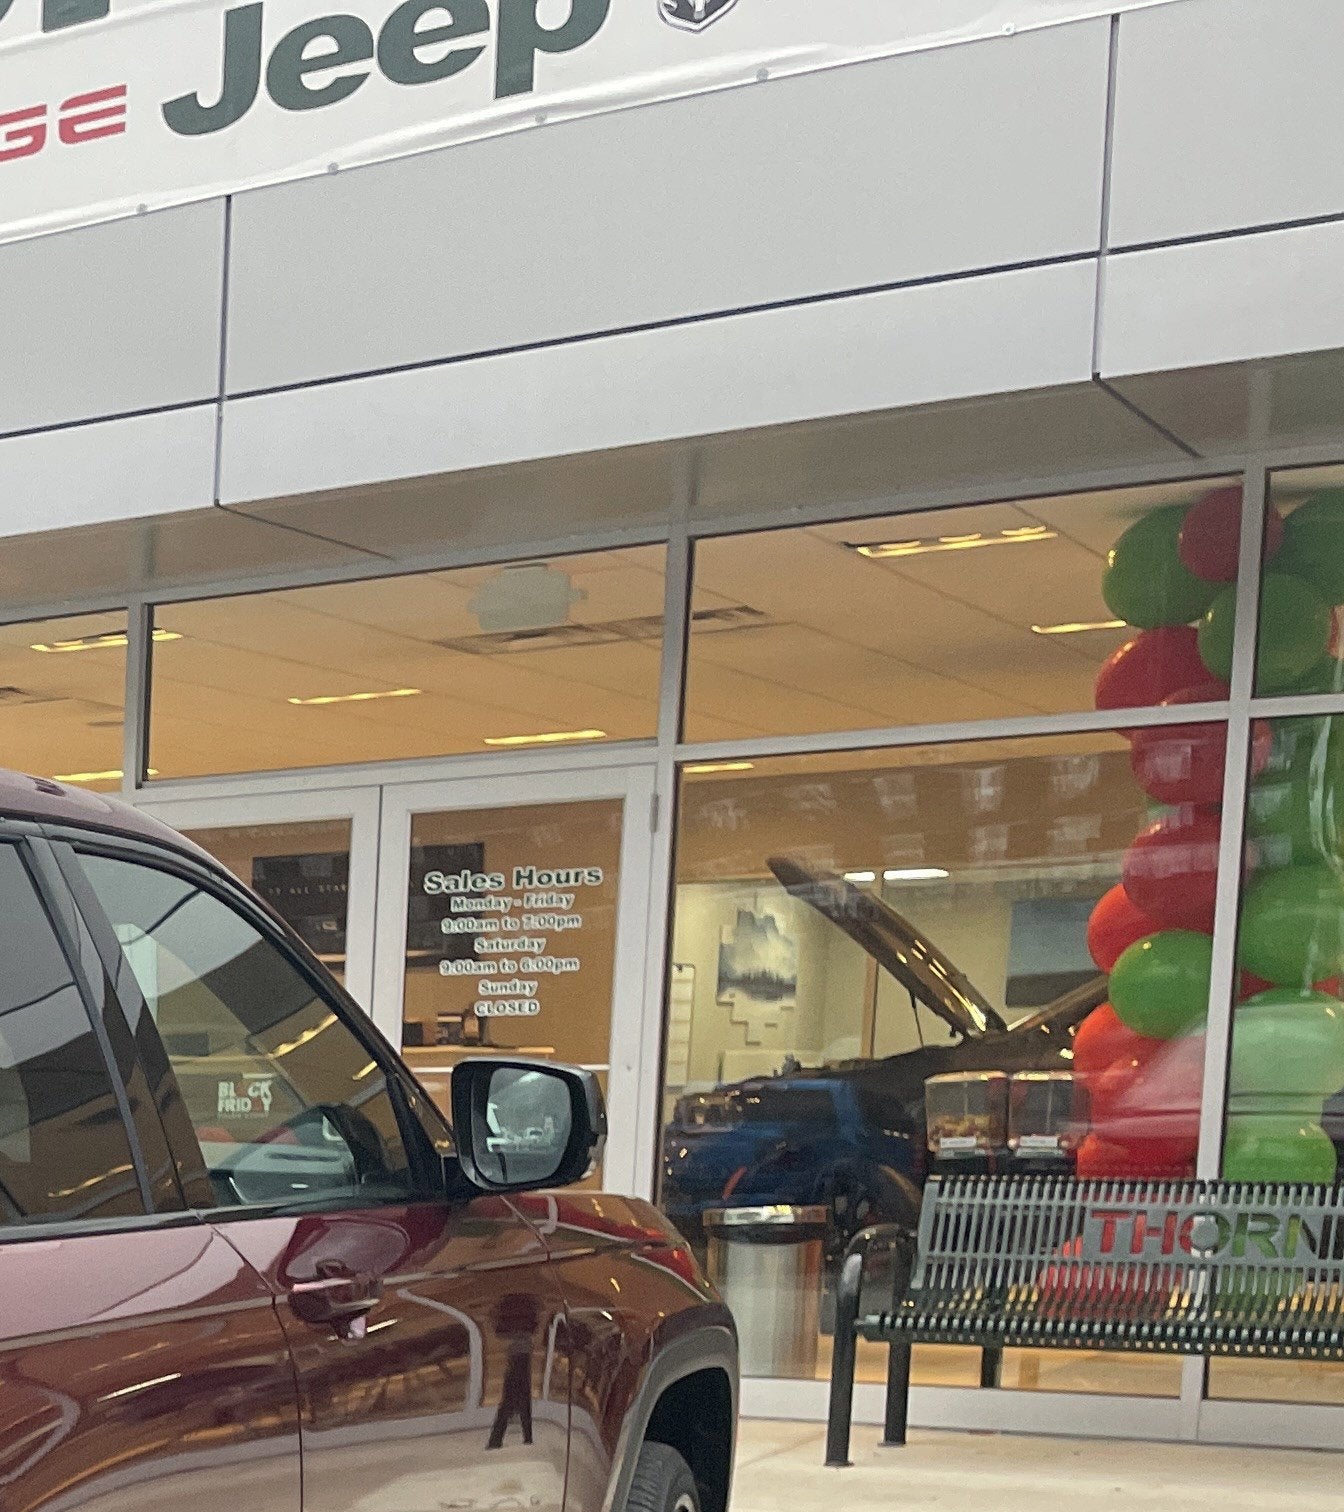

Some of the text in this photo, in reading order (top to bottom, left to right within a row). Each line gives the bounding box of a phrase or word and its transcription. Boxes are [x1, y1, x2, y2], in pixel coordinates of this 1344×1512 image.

[162, 0, 613, 136] Jeep
[424, 866, 603, 894] Sales Hours
[451, 895, 511, 912] Monday
[524, 893, 574, 910] Friday
[501, 916, 520, 931] to
[474, 936, 546, 954] Saturday
[499, 958, 518, 973] to
[477, 979, 538, 997] Sunday
[474, 999, 540, 1016] CLOSED
